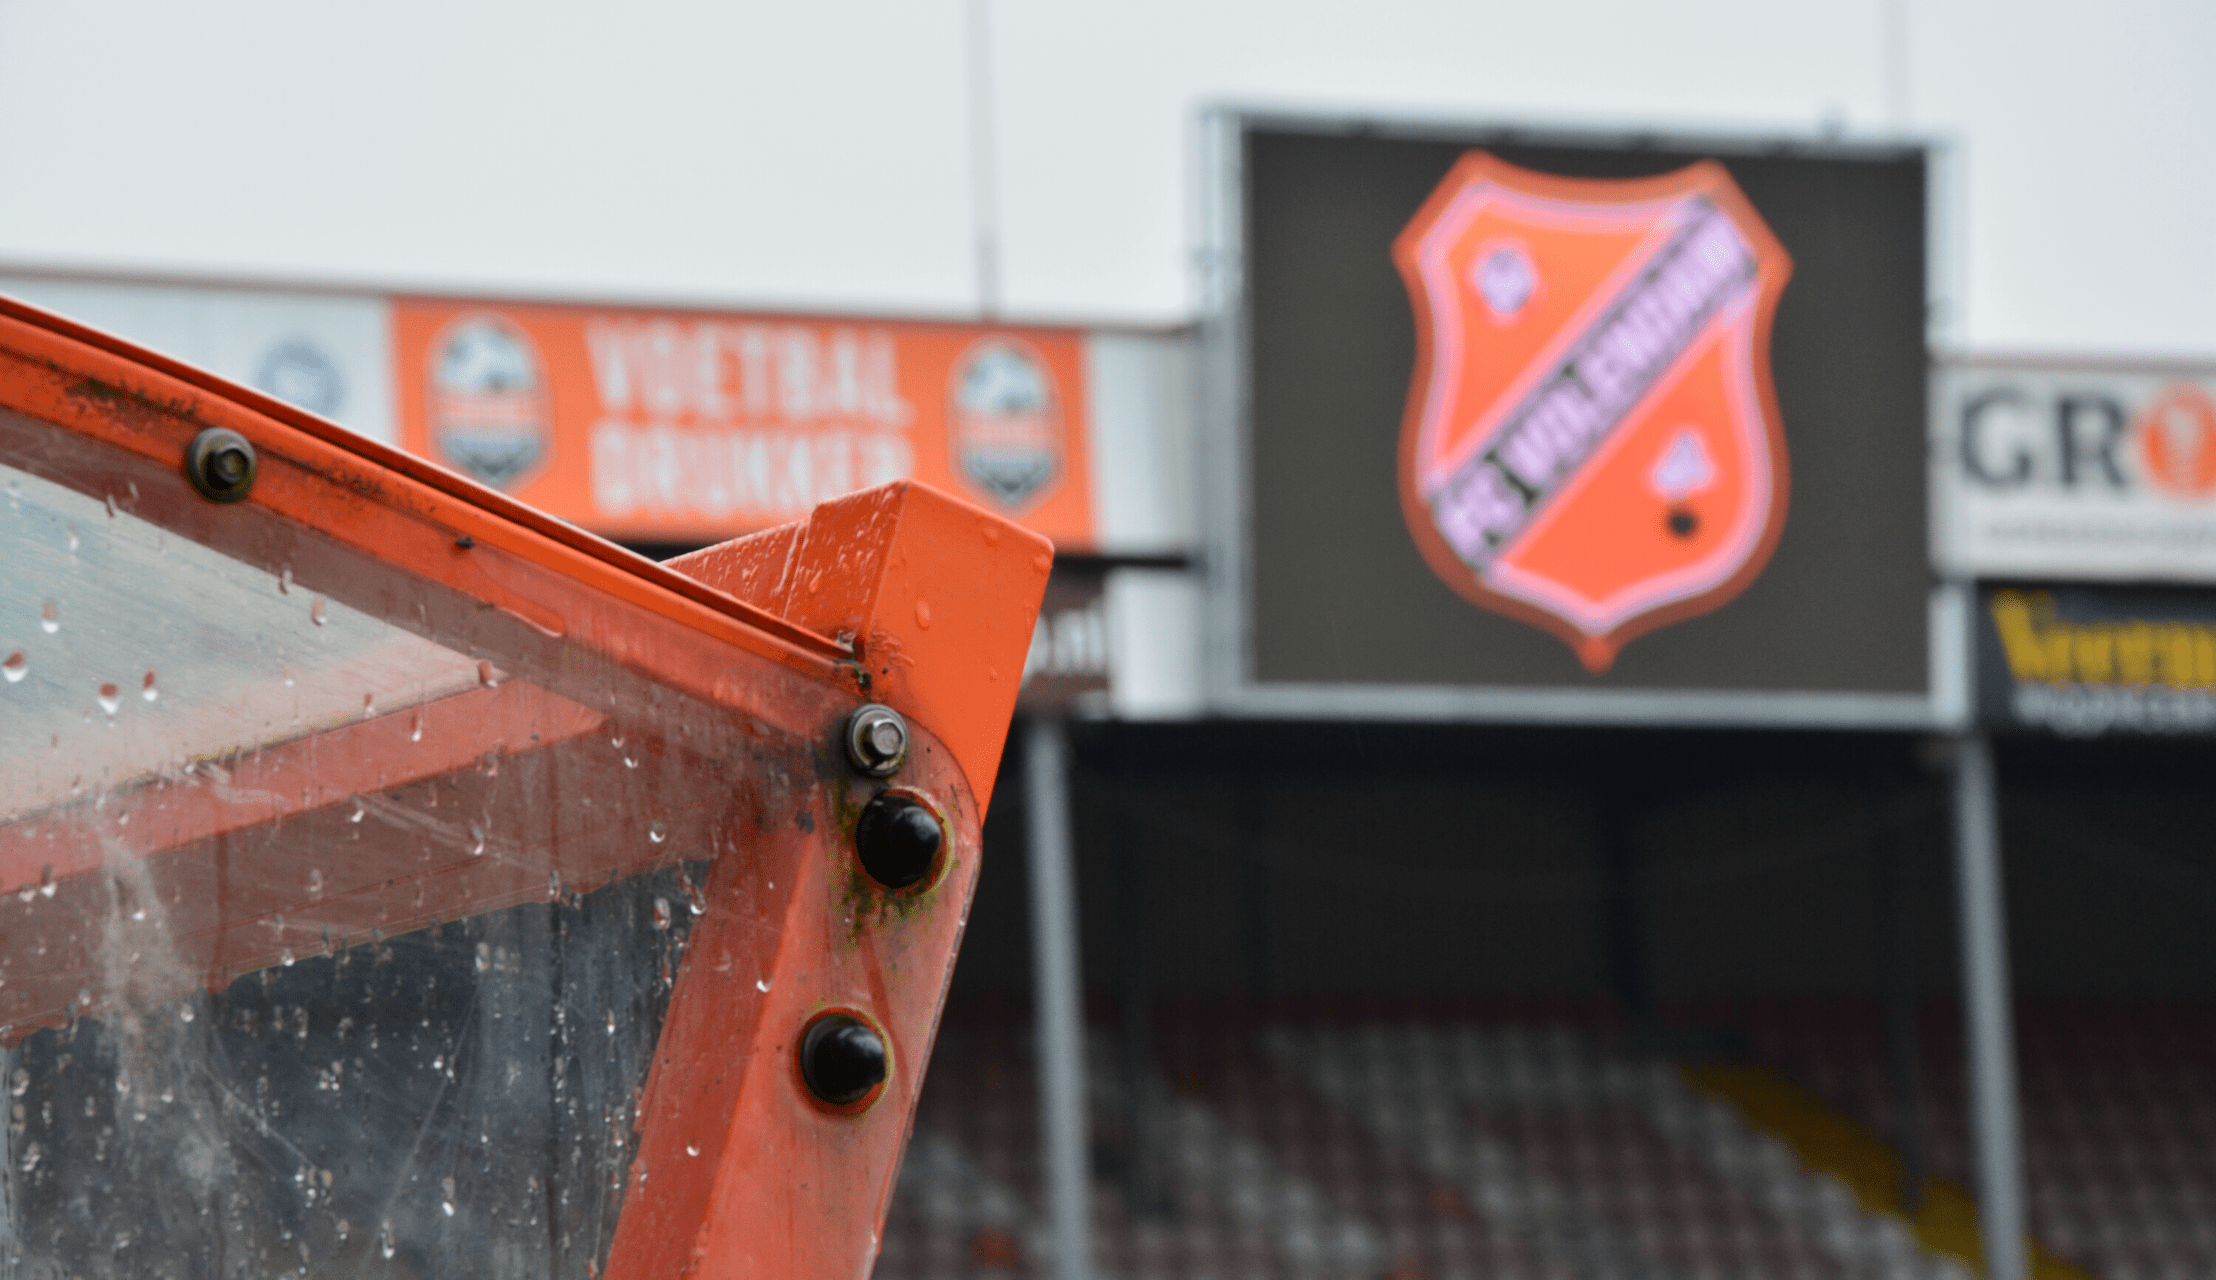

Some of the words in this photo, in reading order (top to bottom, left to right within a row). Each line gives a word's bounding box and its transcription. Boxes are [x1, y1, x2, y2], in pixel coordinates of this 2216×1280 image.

[587, 318, 913, 421] VOETBAL
[591, 424, 913, 517] DRUKKER
[1436, 459, 1527, 564] FC
